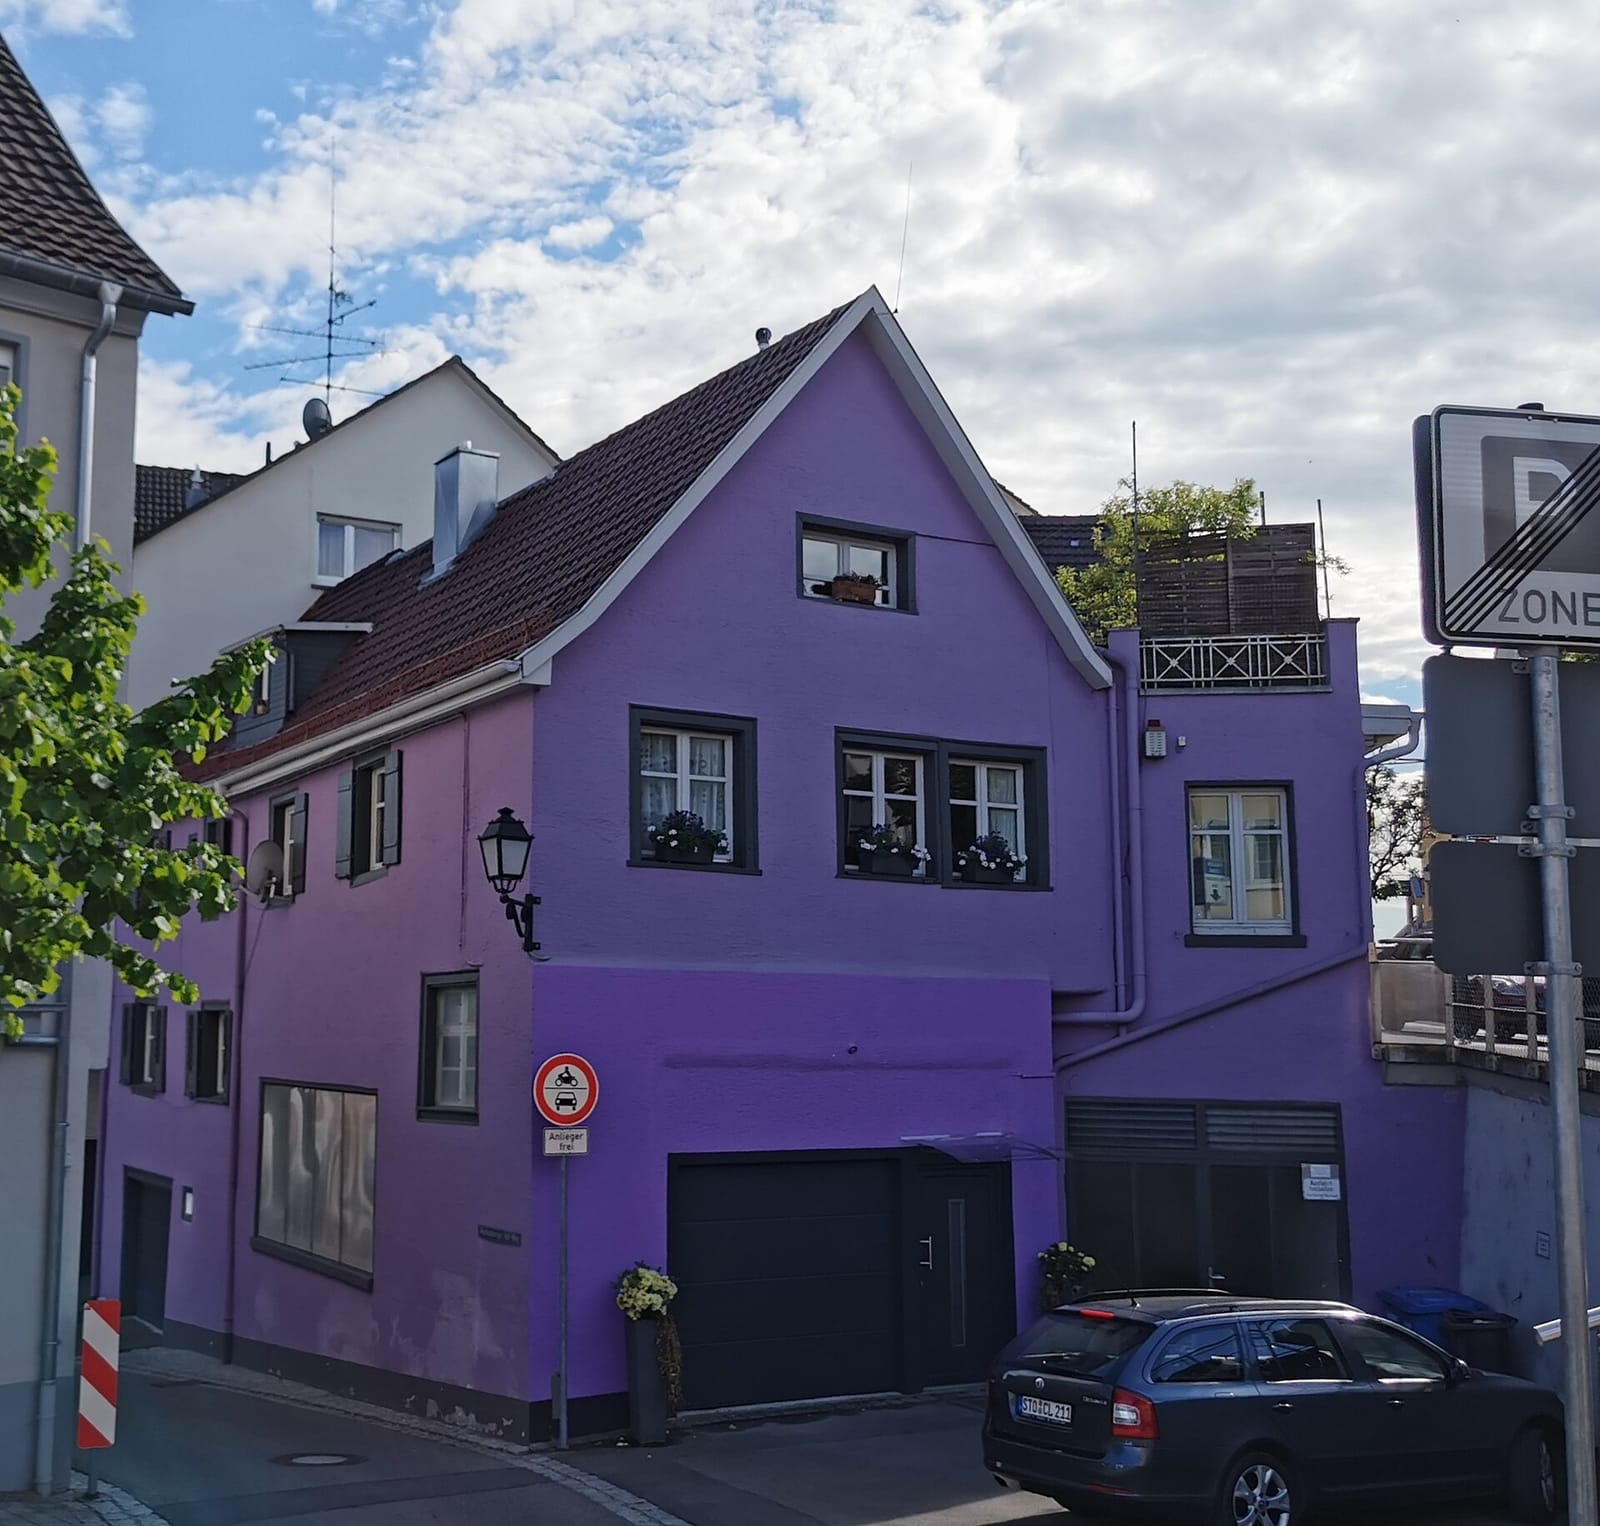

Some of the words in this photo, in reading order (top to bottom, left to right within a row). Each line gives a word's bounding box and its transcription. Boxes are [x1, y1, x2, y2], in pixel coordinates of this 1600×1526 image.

[1513, 457, 1577, 551] P
[1498, 589, 1600, 626] ZONE
[549, 1132, 584, 1143] Anlieger
[559, 1142, 575, 1151] frei
